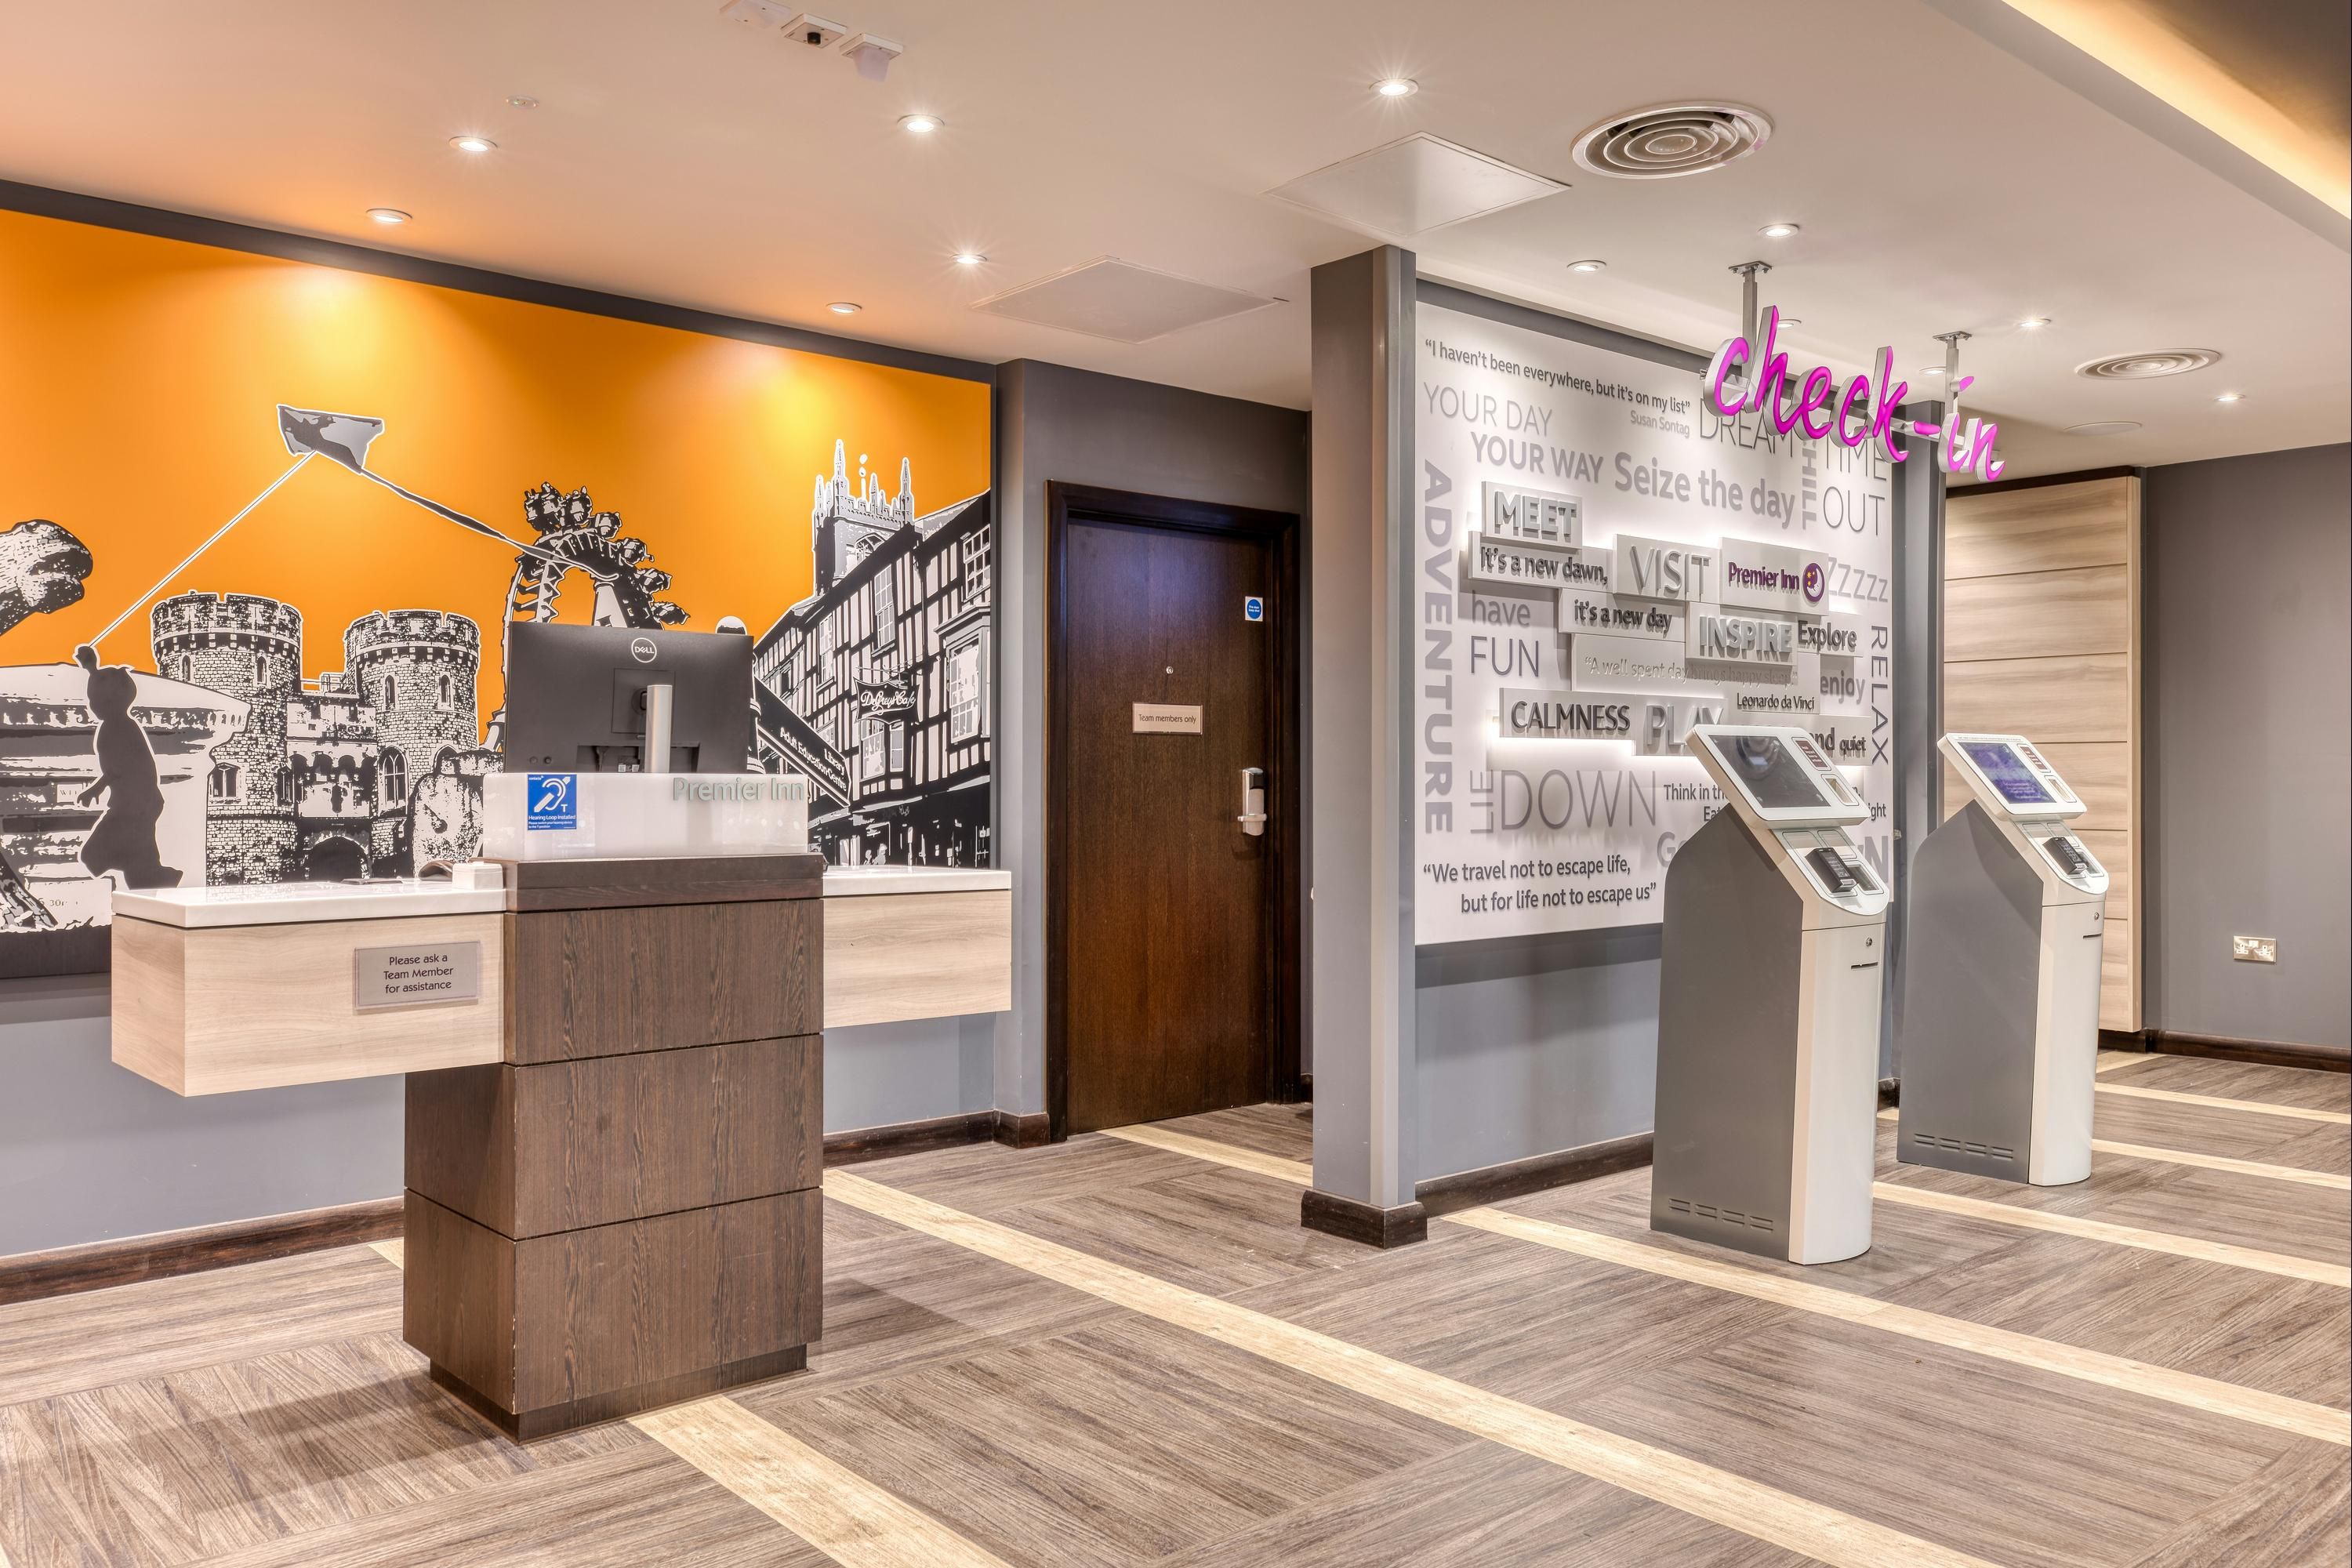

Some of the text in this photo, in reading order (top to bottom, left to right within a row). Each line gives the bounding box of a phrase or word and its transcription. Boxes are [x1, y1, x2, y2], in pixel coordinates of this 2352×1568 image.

[1439, 343, 1486, 368] haven’t
[1490, 354, 1520, 376] been
[1523, 366, 1594, 396] everywhere,
[1596, 379, 1615, 398] but
[1617, 384, 1633, 401] it’s
[1635, 390, 1650, 405] on
[1652, 394, 1668, 412] my
[1705, 305, 2005, 482] check-in
[1424, 382, 1552, 437] YOUR DAY
[1631, 410, 1690, 437] Susan Sontag
[1471, 431, 1604, 484] YOUR WAY
[1614, 452, 1795, 530] Seize the day
[1802, 440, 1817, 530] HILL
[1494, 491, 1577, 538] MEET
[1823, 486, 1885, 536] OUT
[1511, 555, 1523, 573] a
[1525, 556, 1559, 578] new
[1563, 557, 1608, 586] dawn,
[1630, 546, 1711, 596] VISIT
[1729, 561, 1800, 591] Premier Inn
[1472, 590, 1531, 628] have
[1601, 608, 1611, 624] a
[1613, 608, 1643, 627] new
[1647, 608, 1672, 633] day
[1425, 459, 1453, 834] ADVENTURE
[1699, 615, 1792, 657] INSPIRE
[1798, 620, 1857, 651] Explore
[1471, 635, 1539, 677] FUN
[1602, 659, 1628, 676] well
[1632, 662, 1665, 681] spent
[1668, 662, 1689, 684] day
[1729, 665, 1762, 688] happy
[1820, 670, 1866, 705] enjoy
[1737, 692, 1815, 710] Leonardo da Vinci
[1871, 625, 1889, 765] RELAX
[1138, 713, 1197, 724] Team members only
[1511, 701, 1631, 732] CALMNESS
[780, 728, 797, 750] Adult
[798, 742, 827, 775] Education
[1809, 728, 1835, 751] nd
[1839, 735, 1867, 757] quiet
[824, 749, 844, 775] Library
[673, 777, 804, 801] Premier Inn
[1501, 769, 1657, 829] DOWN
[1664, 783, 1727, 800] Think in th
[561, 804, 568, 812] T
[1462, 860, 1505, 881] travel
[1510, 860, 1534, 879] not
[1538, 859, 1553, 877] to
[1556, 856, 1604, 879] escape
[1606, 855, 1631, 876] life,
[1461, 893, 1487, 913] but
[1491, 891, 1513, 911] for
[1516, 890, 1539, 909] life
[1542, 888, 1566, 907] not
[1569, 888, 1584, 905] to
[1587, 885, 1632, 907] escape
[383, 967, 454, 980] Team Member
[389, 956, 420, 966] Please
[423, 954, 439, 964] ask
[385, 981, 452, 994] for assistance
